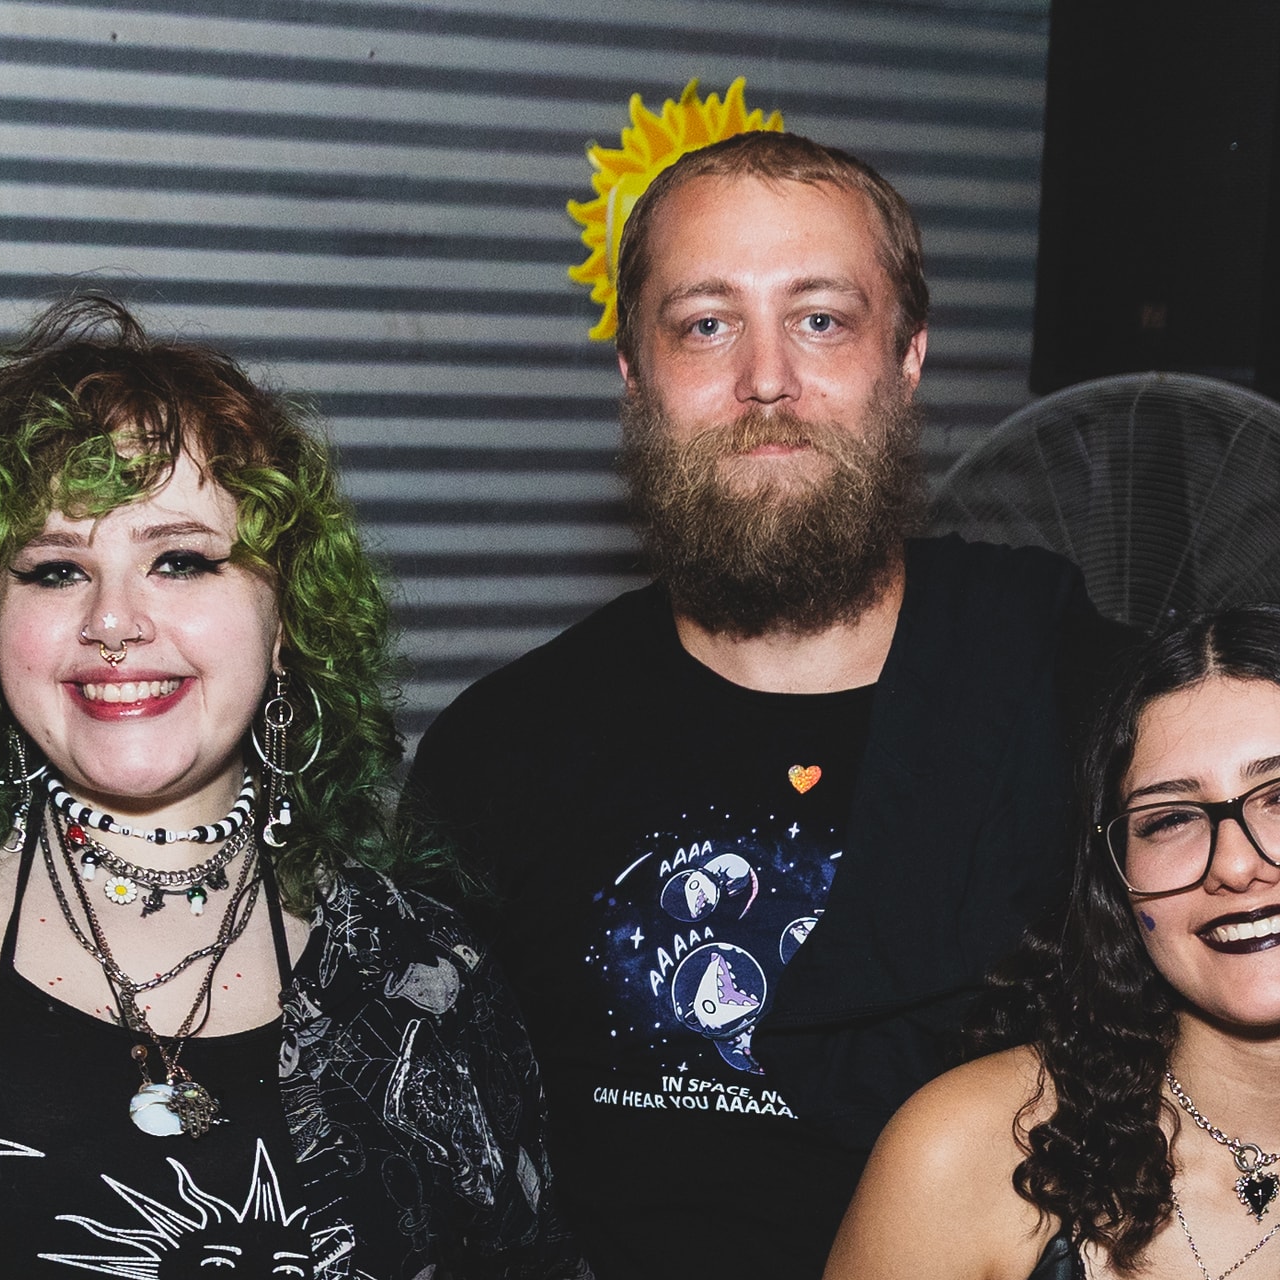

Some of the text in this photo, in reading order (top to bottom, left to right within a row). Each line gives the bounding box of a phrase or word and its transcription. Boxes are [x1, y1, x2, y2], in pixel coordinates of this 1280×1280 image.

[660, 840, 713, 878] AAAA
[593, 1087, 619, 1105] CAN
[622, 1090, 667, 1109] HEAR
[669, 1095, 709, 1110] YOU
[662, 1076, 683, 1092] IN
[687, 1079, 753, 1100] SPACE,
